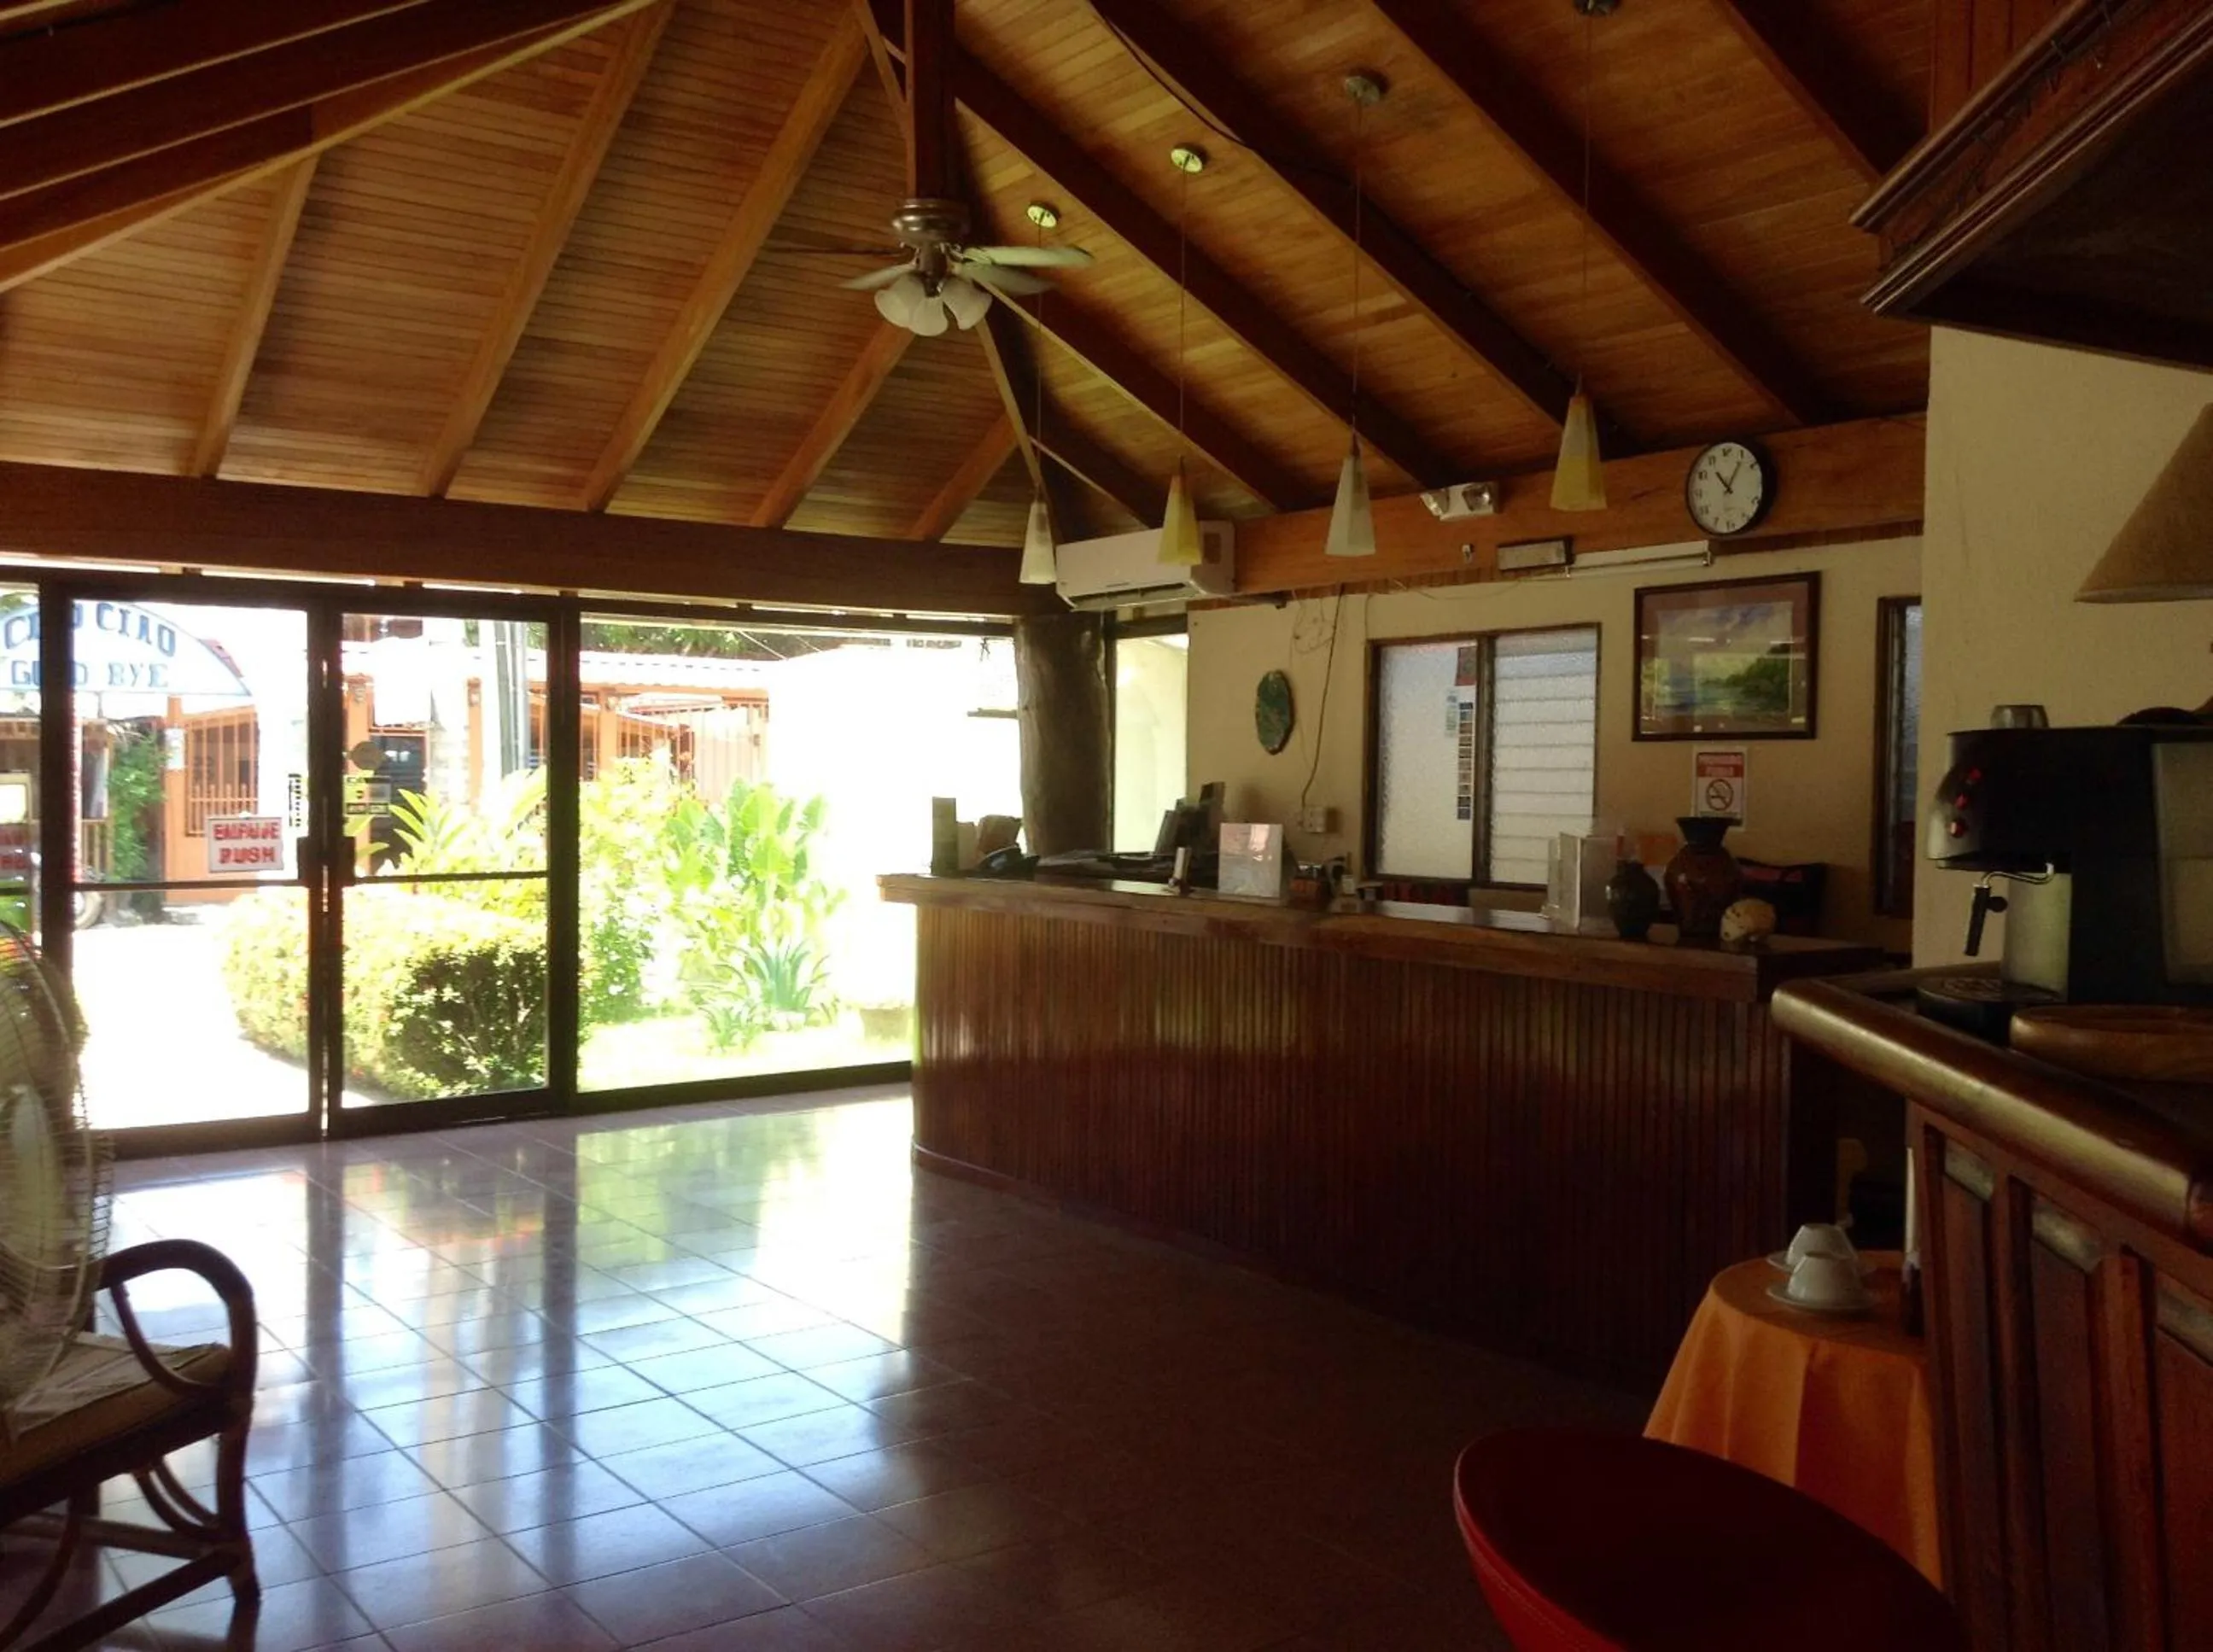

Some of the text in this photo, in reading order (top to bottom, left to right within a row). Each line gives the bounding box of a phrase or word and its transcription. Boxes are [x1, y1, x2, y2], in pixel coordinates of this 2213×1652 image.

[96, 602, 176, 657] CIAO
[108, 663, 168, 687] BYE
[213, 822, 279, 840] EMPUJE
[219, 847, 276, 863] PUSH
